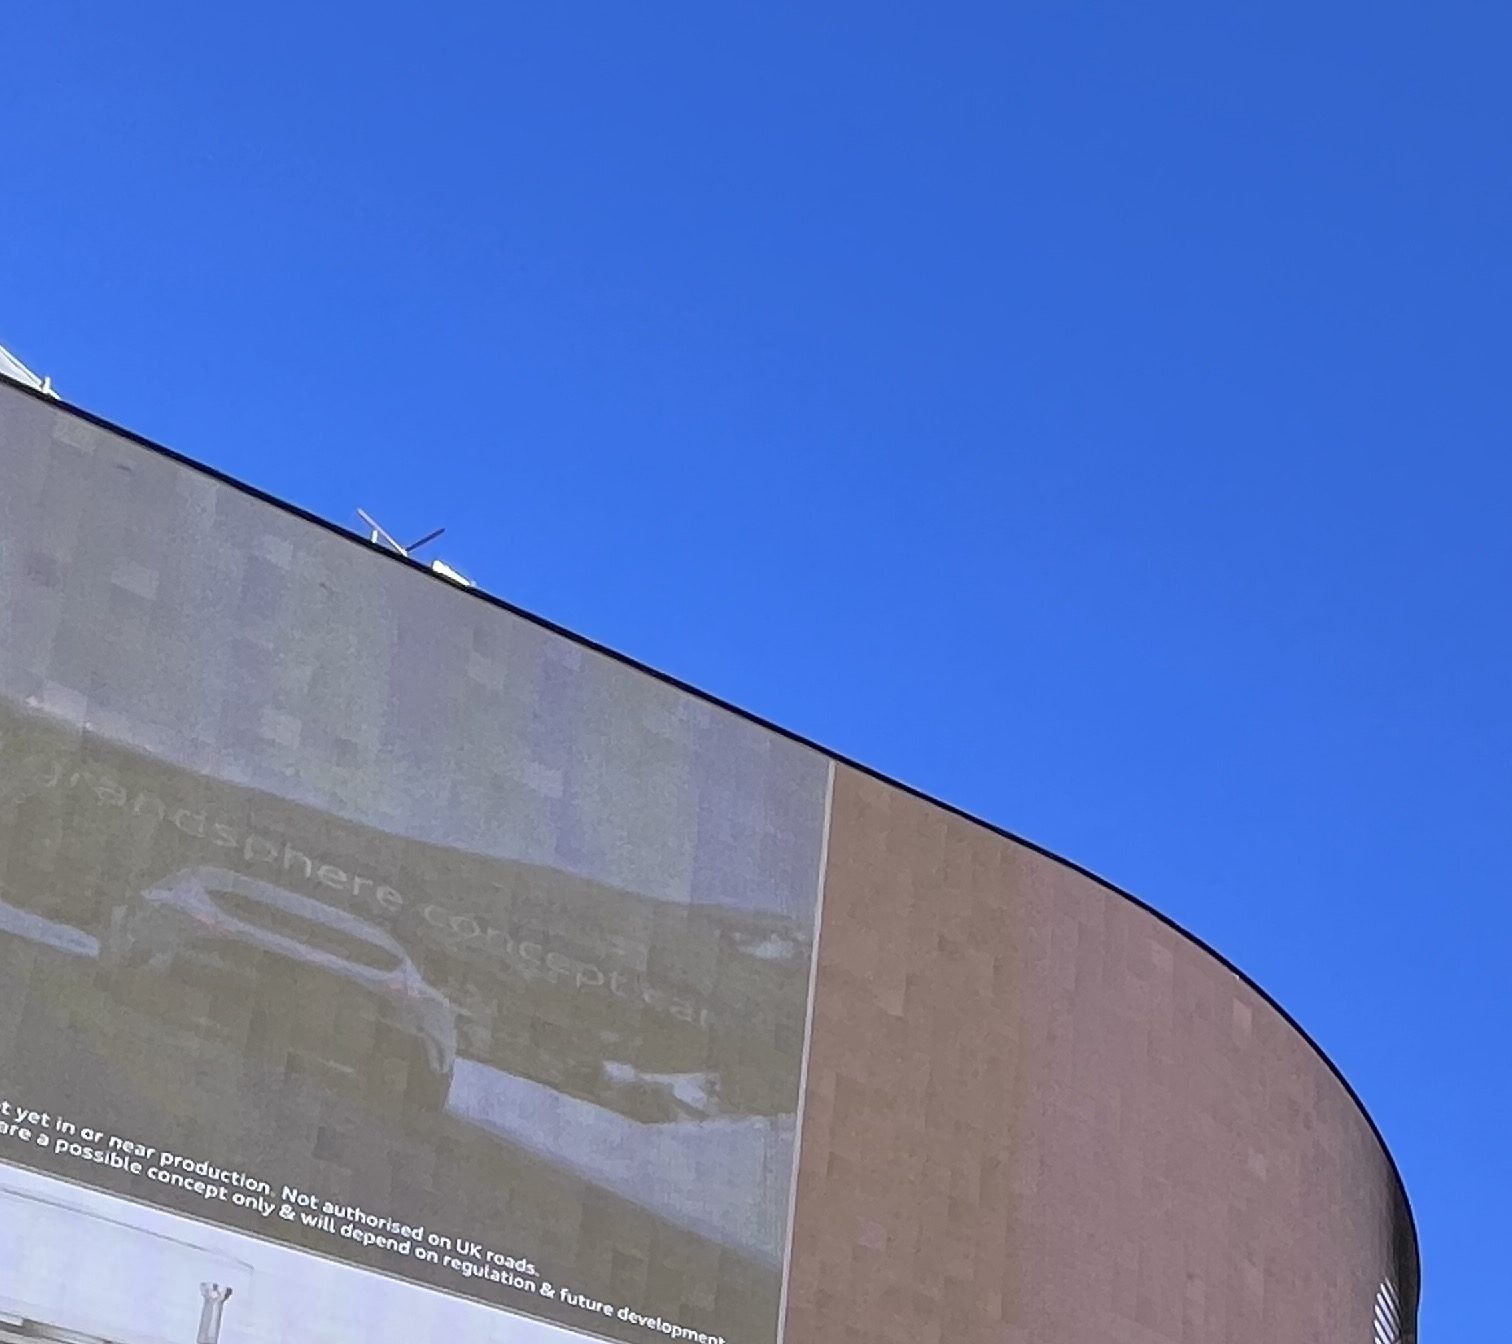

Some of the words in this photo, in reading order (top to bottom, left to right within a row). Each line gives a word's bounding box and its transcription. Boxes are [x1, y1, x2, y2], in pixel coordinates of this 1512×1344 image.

[16, 1107, 51, 1128] yet
[56, 1116, 76, 1135] in
[80, 1127, 104, 1143] or
[109, 1135, 156, 1159] near
[160, 1151, 276, 1197] production.
[282, 1186, 318, 1210] Not
[322, 1200, 424, 1241] authorised
[428, 1234, 451, 1250] on
[455, 1238, 482, 1259] UK
[486, 1250, 540, 1278] roads.
[36, 1132, 50, 1147] a
[55, 1138, 142, 1175] possible
[147, 1167, 228, 1201] concept
[232, 1193, 275, 1217] only
[279, 1203, 295, 1221] &
[300, 1211, 336, 1234] will
[340, 1223, 411, 1255] depend
[414, 1246, 438, 1264] on
[442, 1256, 536, 1293] regulation
[539, 1282, 555, 1299] &
[560, 1288, 614, 1317] future
